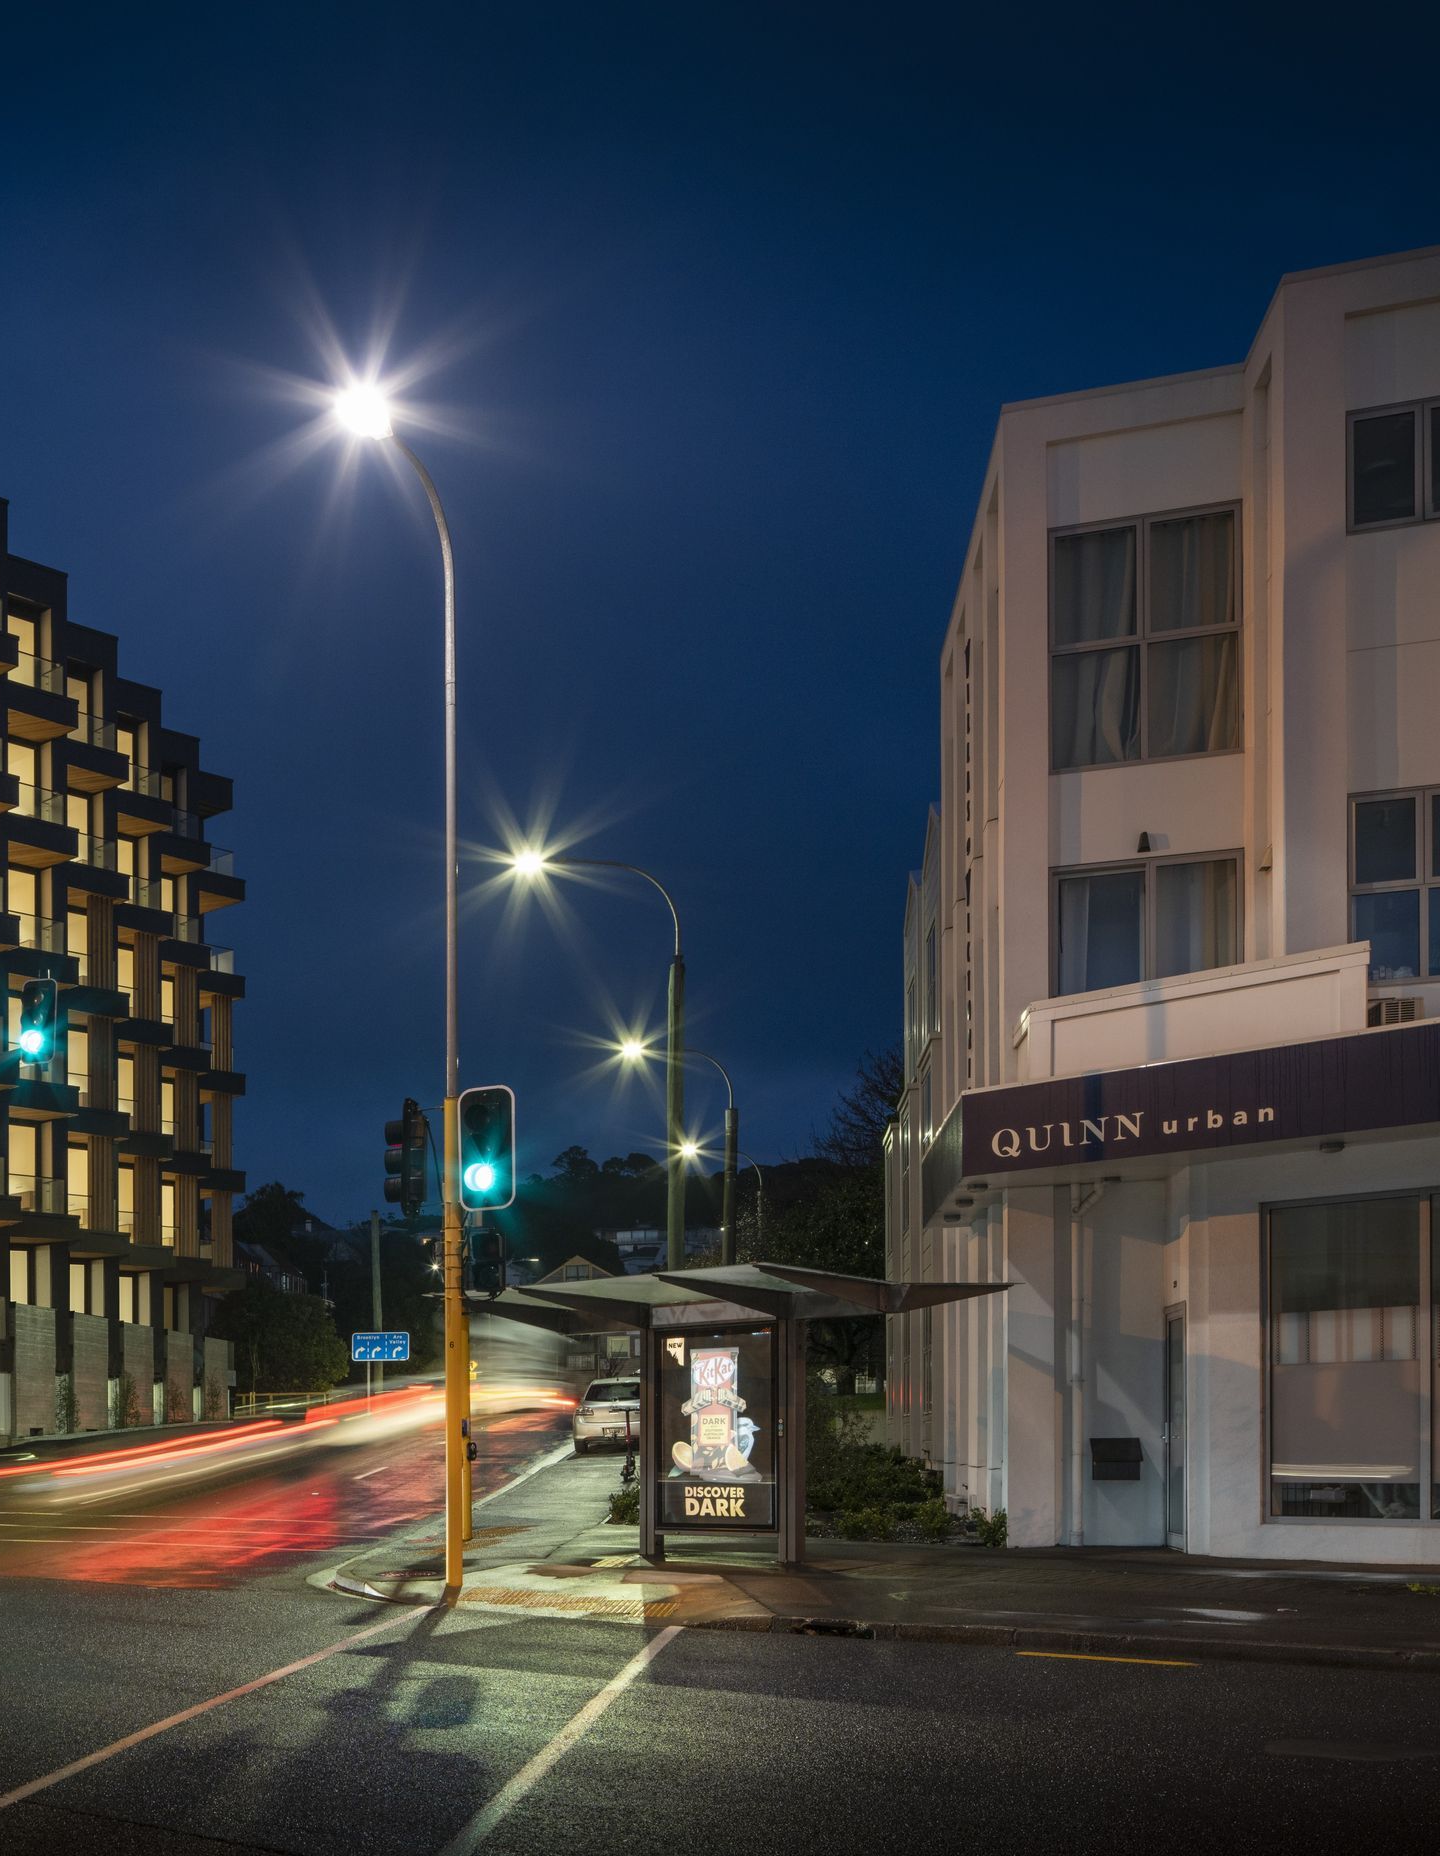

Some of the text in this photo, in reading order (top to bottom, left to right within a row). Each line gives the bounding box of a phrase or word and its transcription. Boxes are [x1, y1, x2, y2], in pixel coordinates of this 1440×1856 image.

[991, 1106, 1275, 1158] QUINN urban
[449, 1341, 455, 1349] 6
[698, 1357, 733, 1386] KitKat
[685, 1486, 744, 1498] DISCOVER
[685, 1497, 746, 1517] DARK
